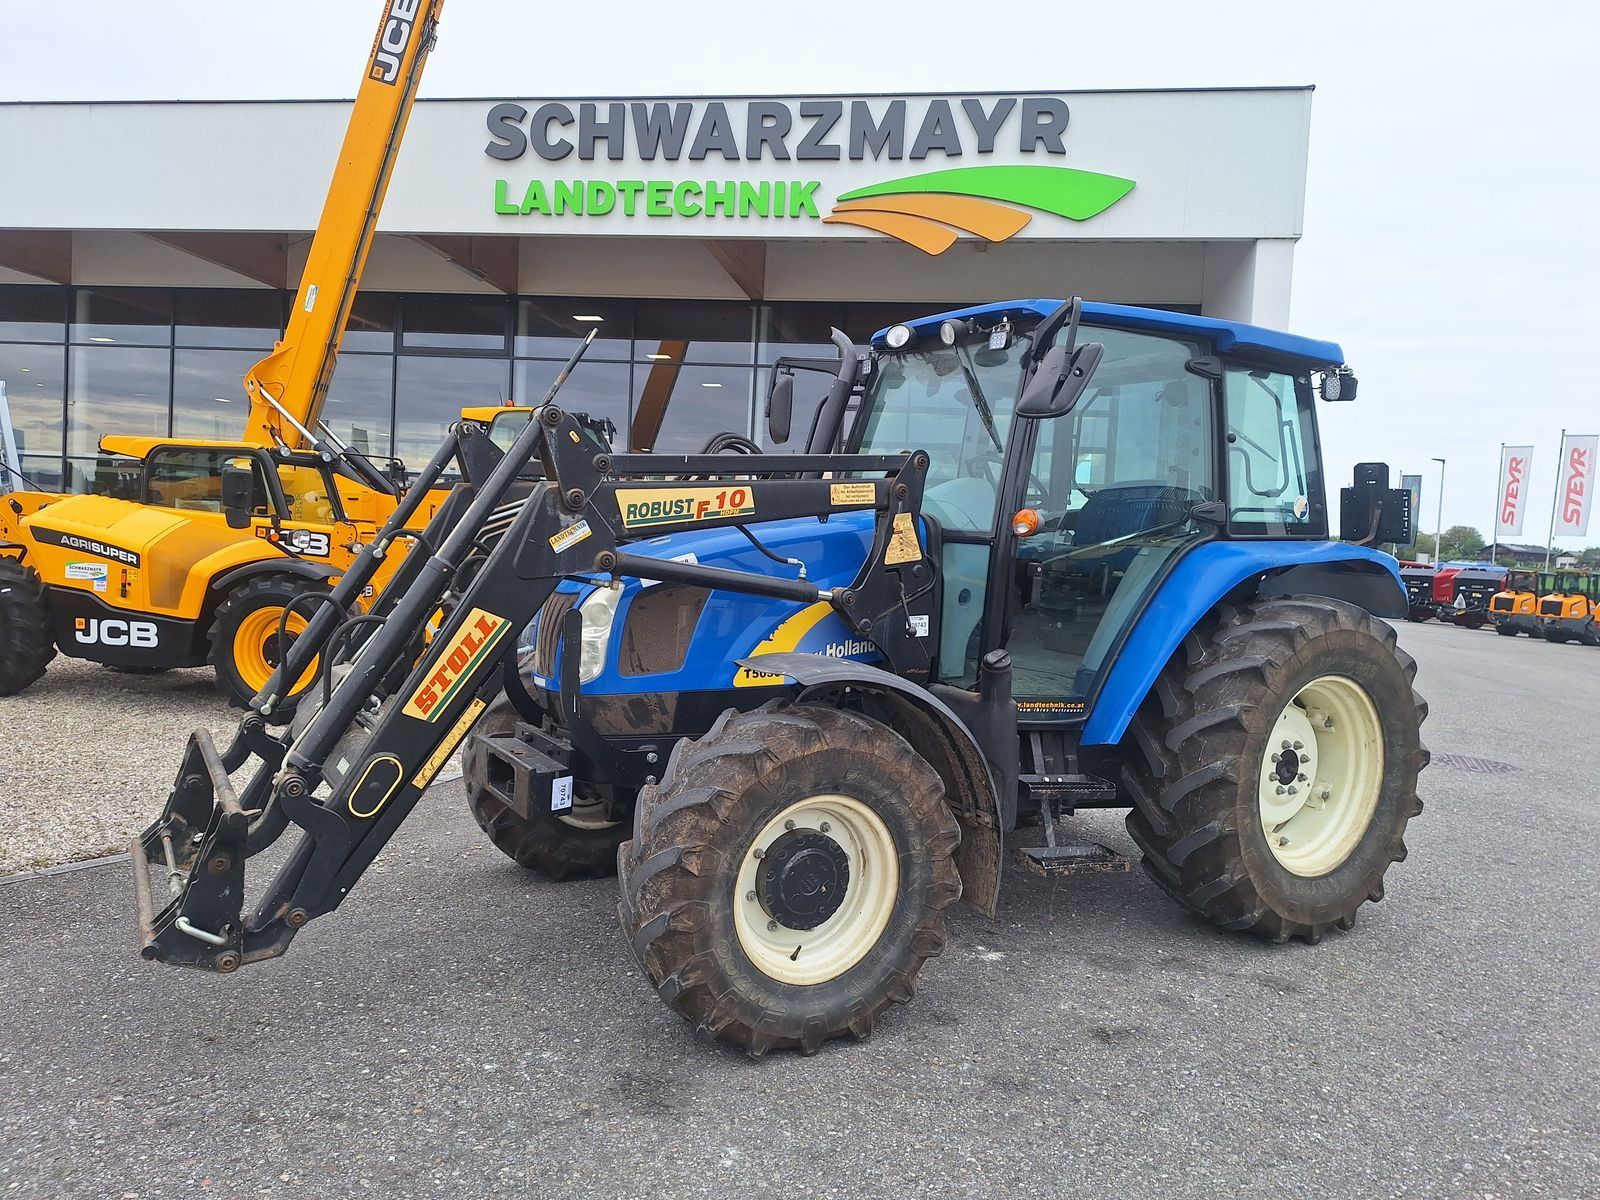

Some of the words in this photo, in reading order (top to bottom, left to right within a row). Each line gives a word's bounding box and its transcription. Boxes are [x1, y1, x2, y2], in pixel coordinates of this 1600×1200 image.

[485, 97, 1071, 162] SCHWARZMAYR
[495, 178, 821, 220] LANDTECHNIK
[626, 498, 695, 519] ROBUST
[696, 500, 711, 519] F
[715, 489, 746, 510] 10
[1502, 457, 1523, 527] STEYR
[1563, 448, 1587, 527] STEYR
[60, 535, 137, 564] AGRISUPER
[75, 618, 159, 648] JCB
[413, 614, 498, 716] STOLL
